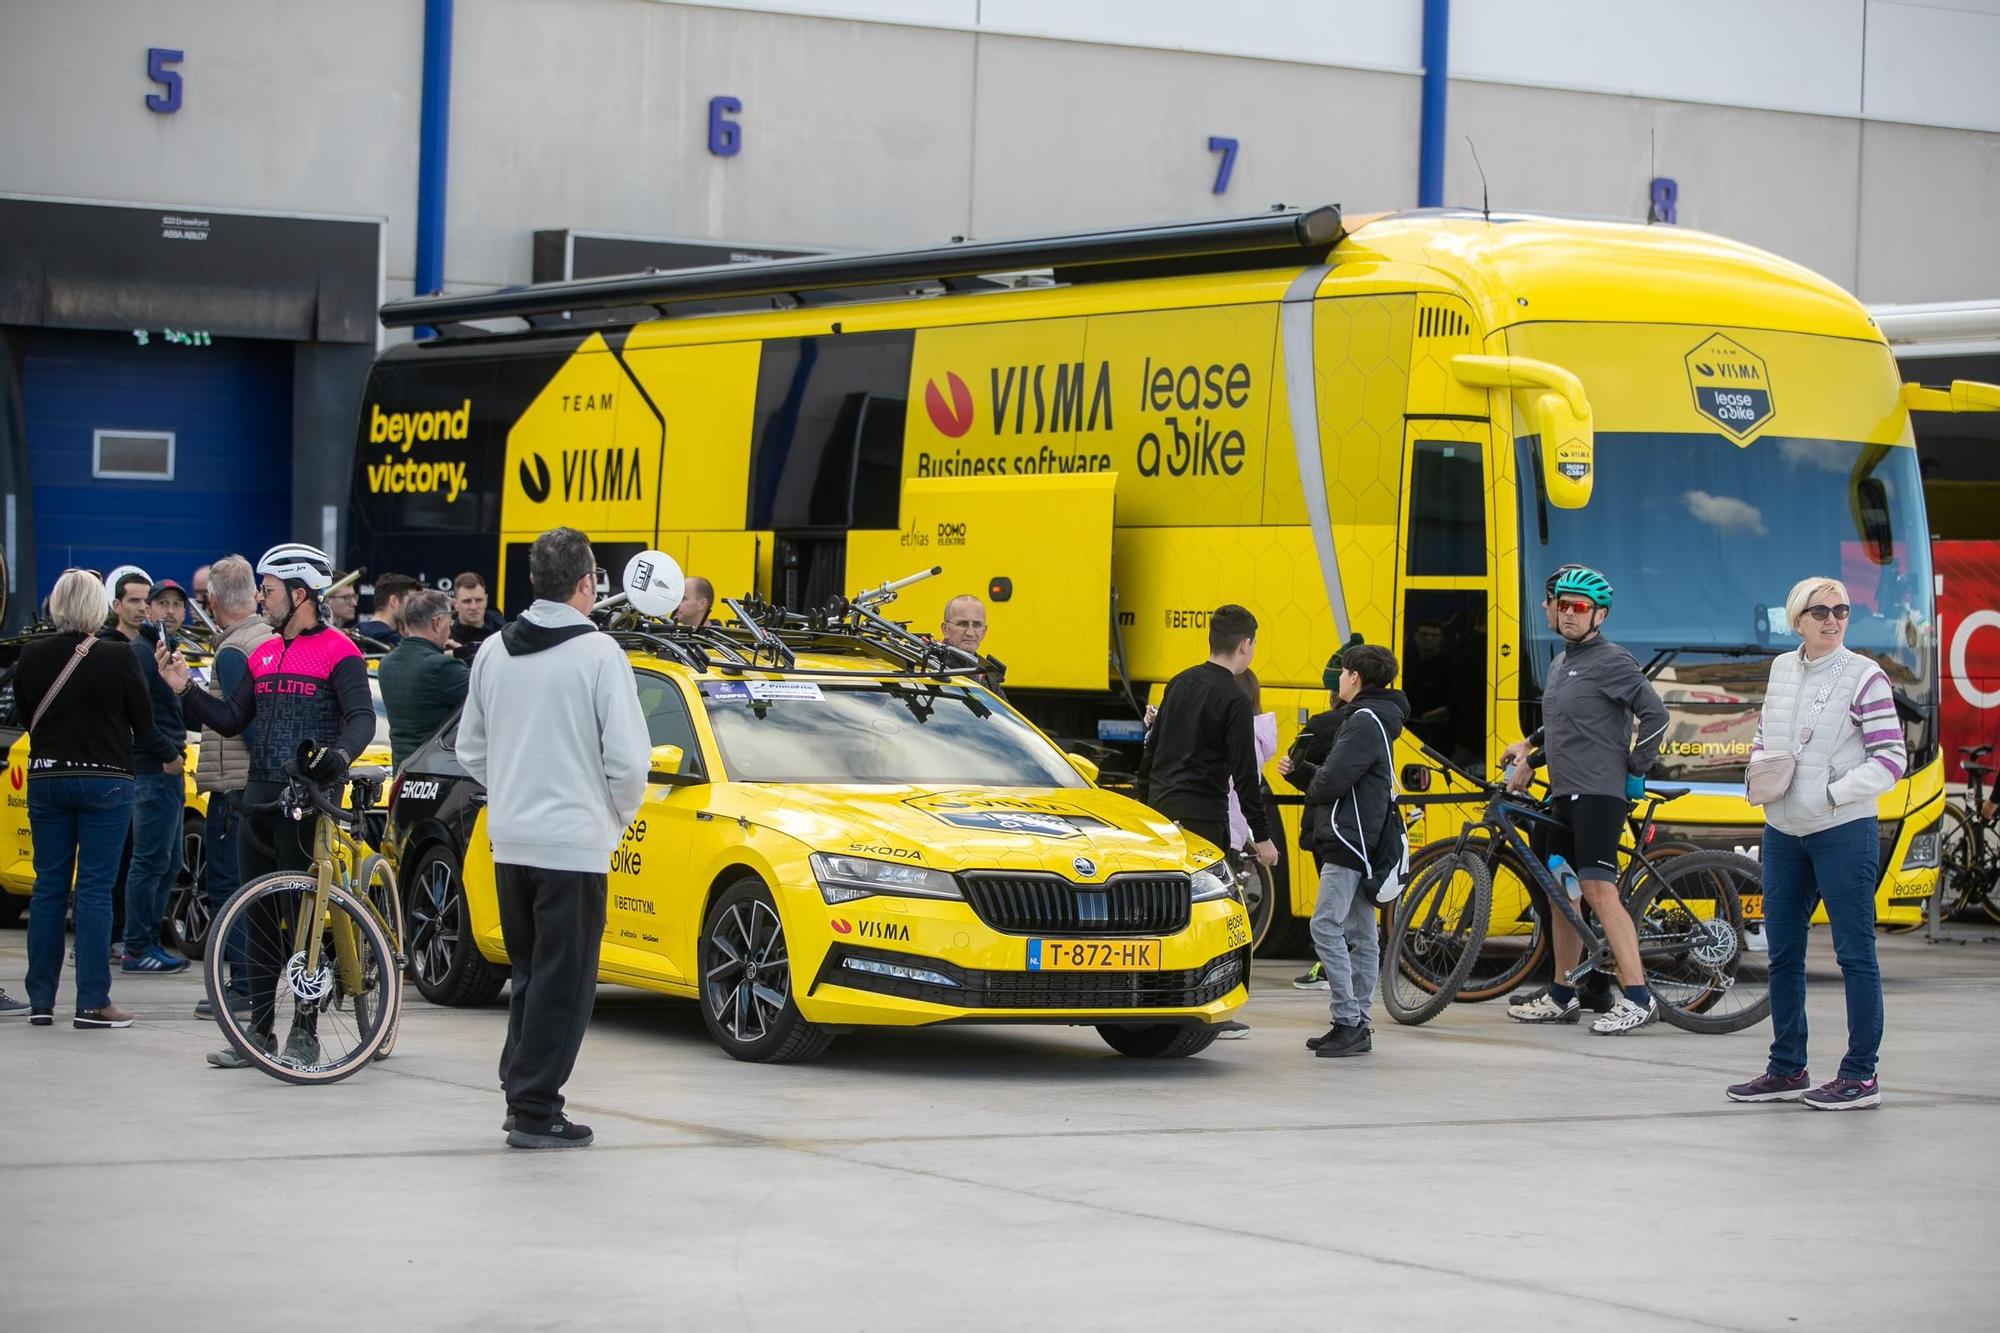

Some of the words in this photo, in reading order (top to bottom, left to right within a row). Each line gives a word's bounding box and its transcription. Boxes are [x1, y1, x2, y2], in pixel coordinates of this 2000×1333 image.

[146, 48, 184, 114] 5
[708, 96, 742, 157] 6
[1208, 137, 1239, 195] 7
[1140, 357, 1251, 413] lease
[1717, 363, 1760, 380] VISMA
[562, 394, 613, 412] TEAM
[991, 360, 1113, 436] VISMA
[1714, 391, 1752, 406] lease
[370, 399, 471, 453] beyond
[367, 454, 468, 503] victory.
[562, 447, 641, 503] VISMA
[918, 451, 1006, 478] Business
[1013, 446, 1111, 475] software
[938, 523, 966, 537] DOMO
[859, 920, 909, 941] VISMA
[1226, 914, 1244, 931] lease
[1050, 944, 1150, 966] T-872-HK
